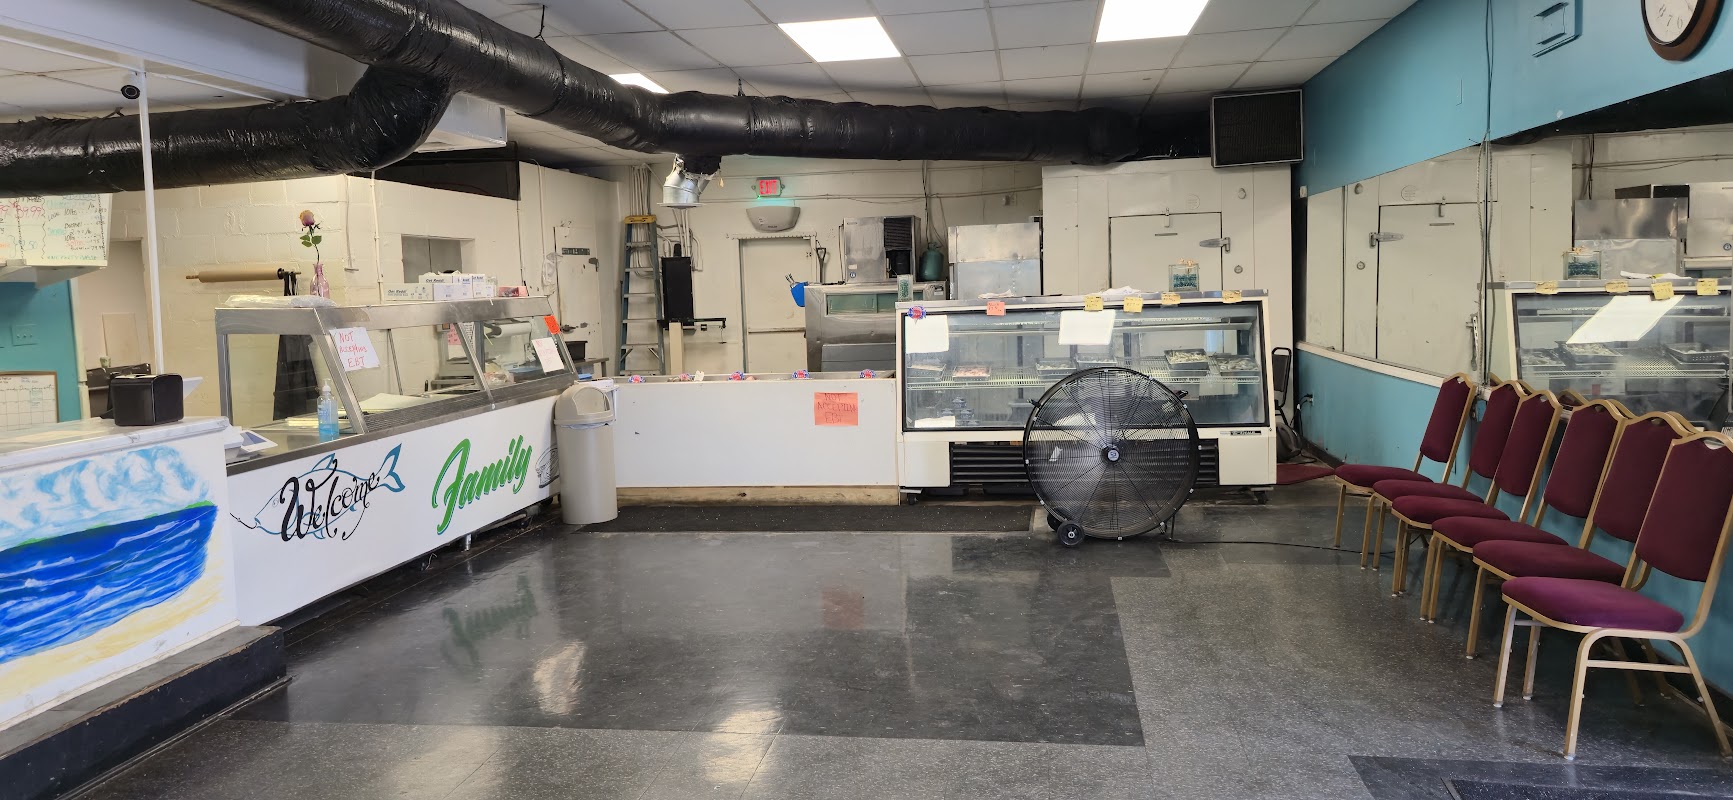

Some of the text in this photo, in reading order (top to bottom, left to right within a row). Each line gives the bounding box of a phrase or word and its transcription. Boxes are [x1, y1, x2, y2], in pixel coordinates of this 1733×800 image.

[1667, 14, 1673, 27] 7
[759, 179, 777, 195] EXIT
[339, 331, 354, 343] NOT
[347, 356, 365, 368] EBT
[824, 393, 842, 402] NOT
[432, 435, 533, 536] Family
[279, 459, 382, 542] Welcome
